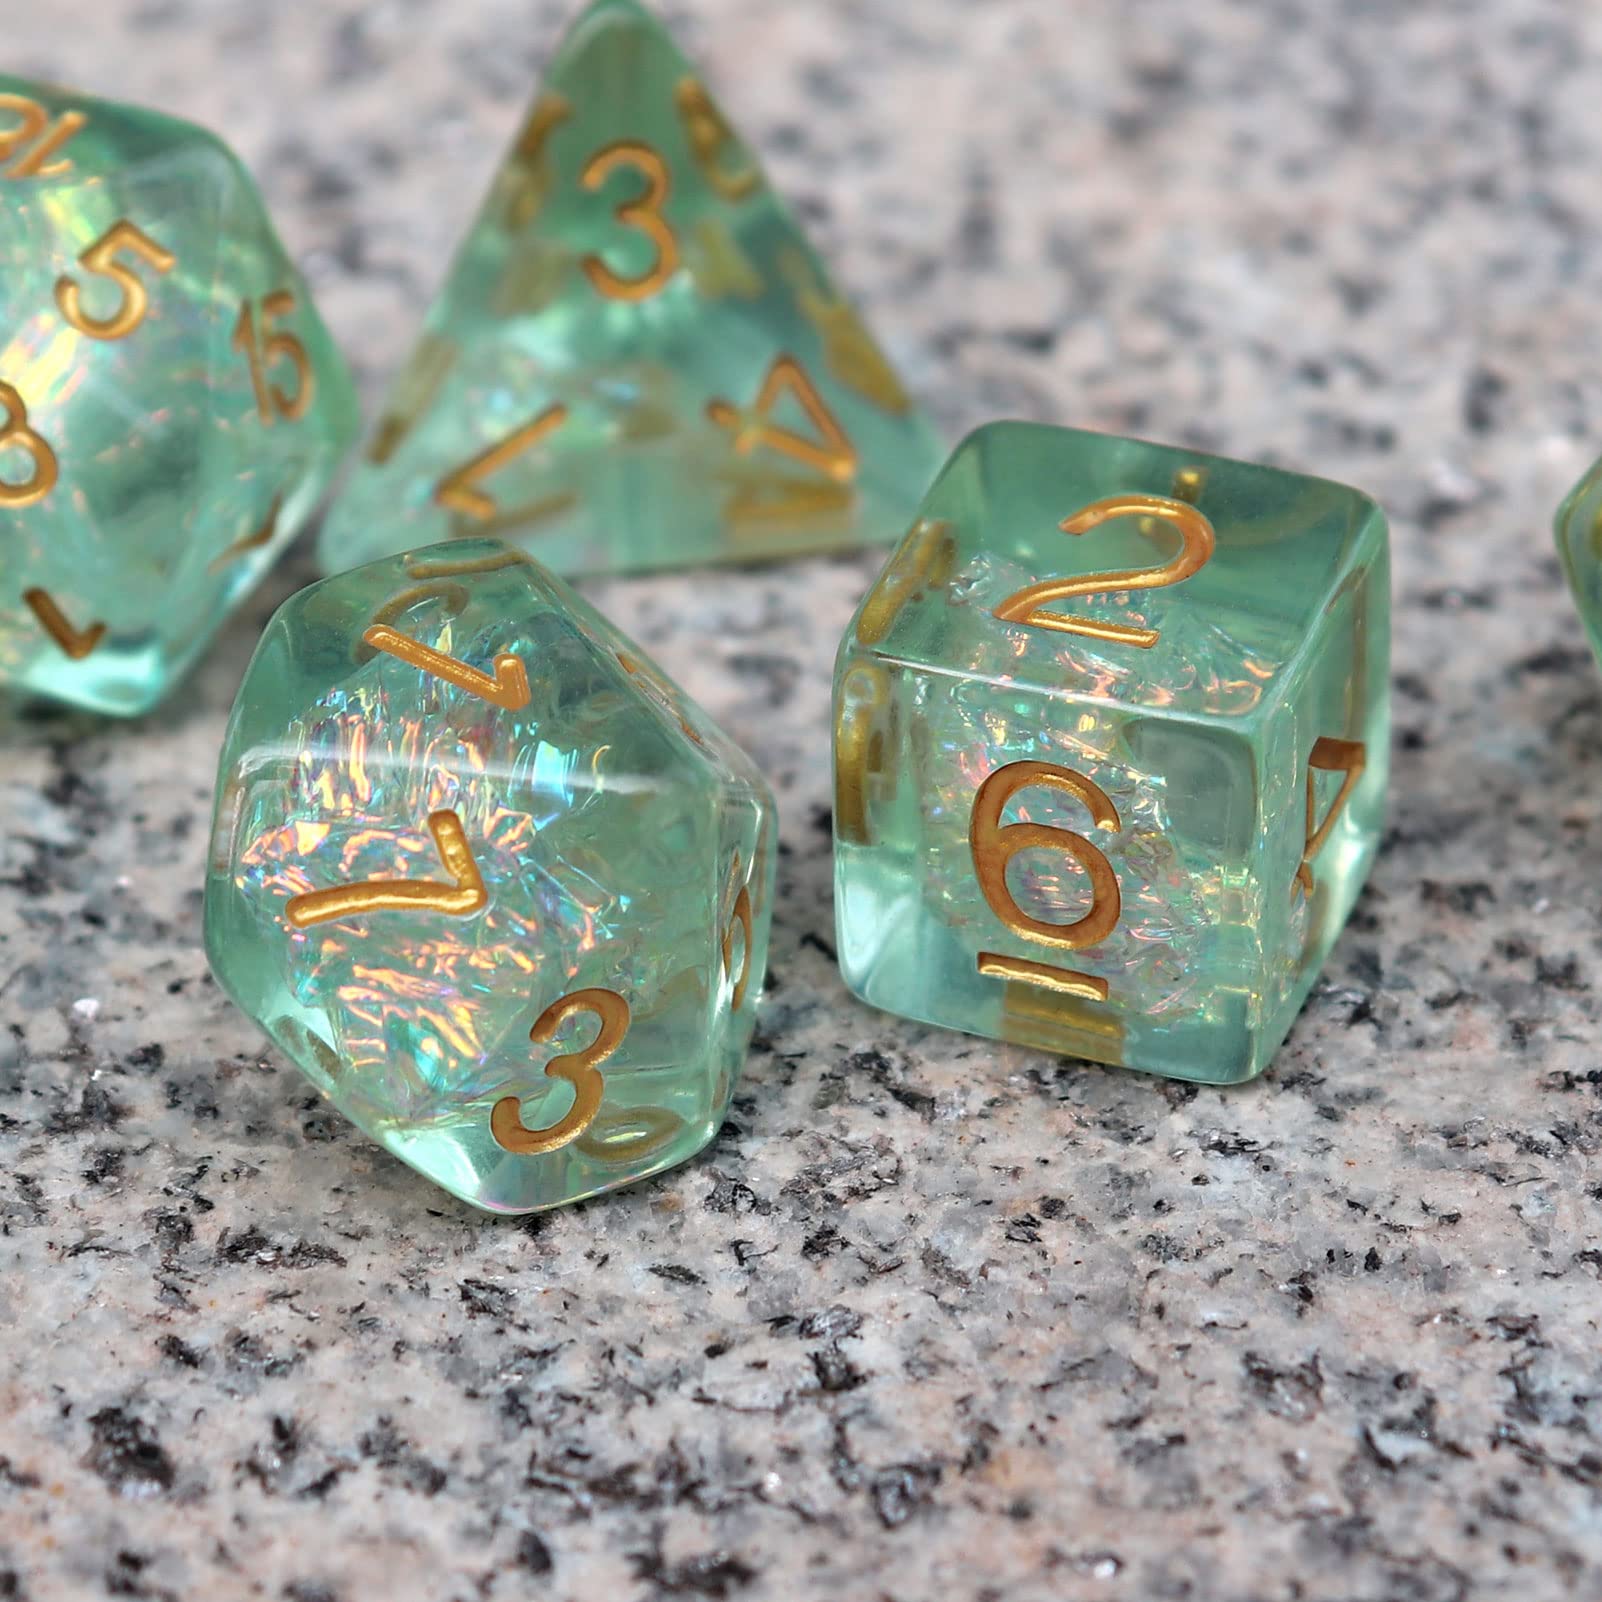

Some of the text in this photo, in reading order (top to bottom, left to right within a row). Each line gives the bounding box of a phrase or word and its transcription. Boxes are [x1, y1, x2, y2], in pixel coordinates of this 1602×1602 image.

[56, 219, 175, 341] 5
[582, 140, 679, 301] 3
[232, 290, 313, 427] 15
[707, 355, 857, 482] 4
[992, 495, 1215, 649] 2
[285, 809, 489, 929] 7
[968, 760, 1122, 950] 6
[490, 987, 631, 1154] 3
